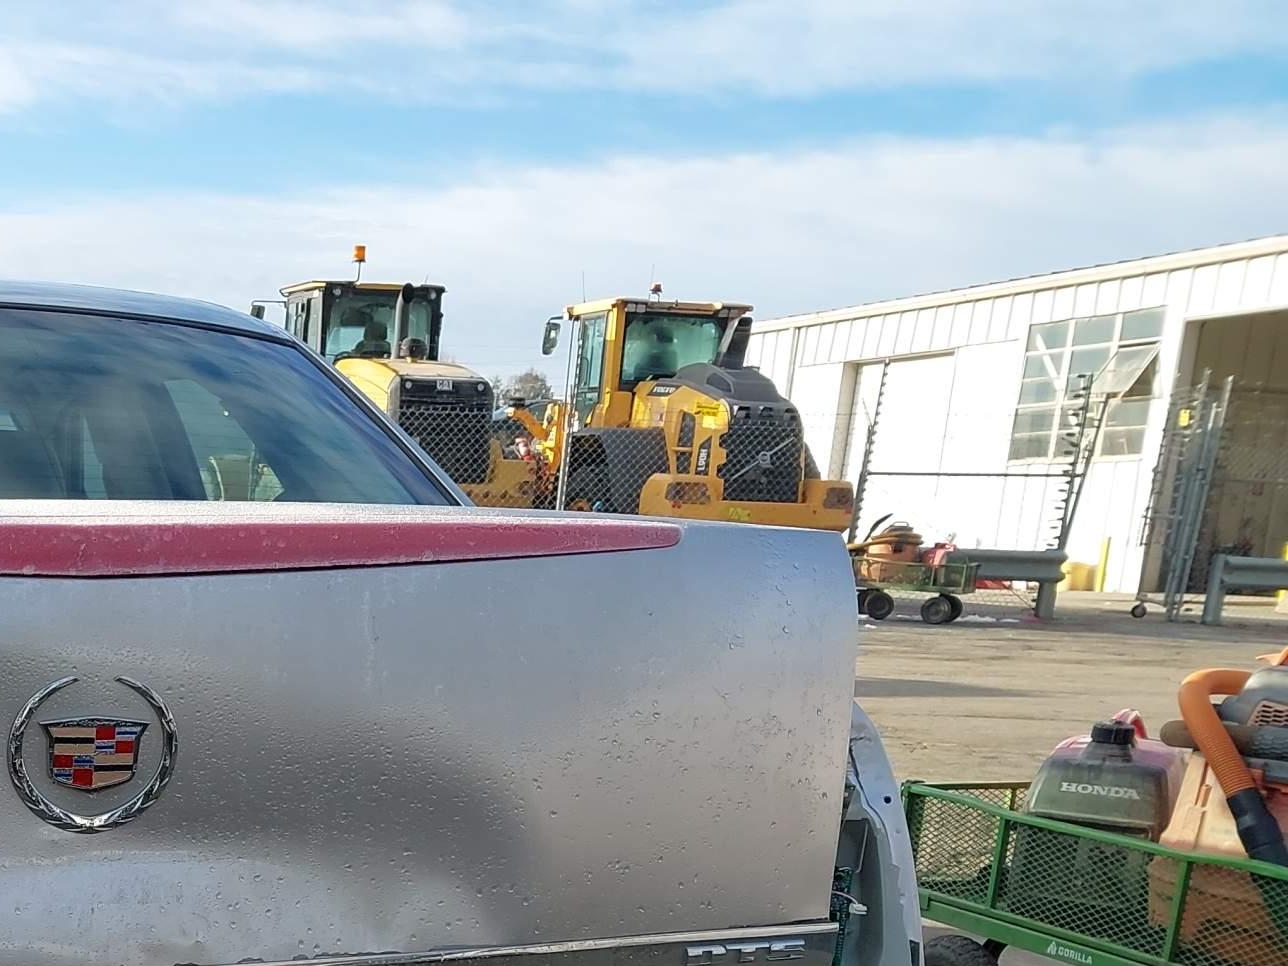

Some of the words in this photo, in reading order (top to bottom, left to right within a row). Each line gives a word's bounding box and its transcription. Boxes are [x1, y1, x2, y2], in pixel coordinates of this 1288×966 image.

[1060, 781, 1141, 800] HONDA
[685, 939, 806, 966] DTS
[1057, 946, 1093, 965] GORILLA
